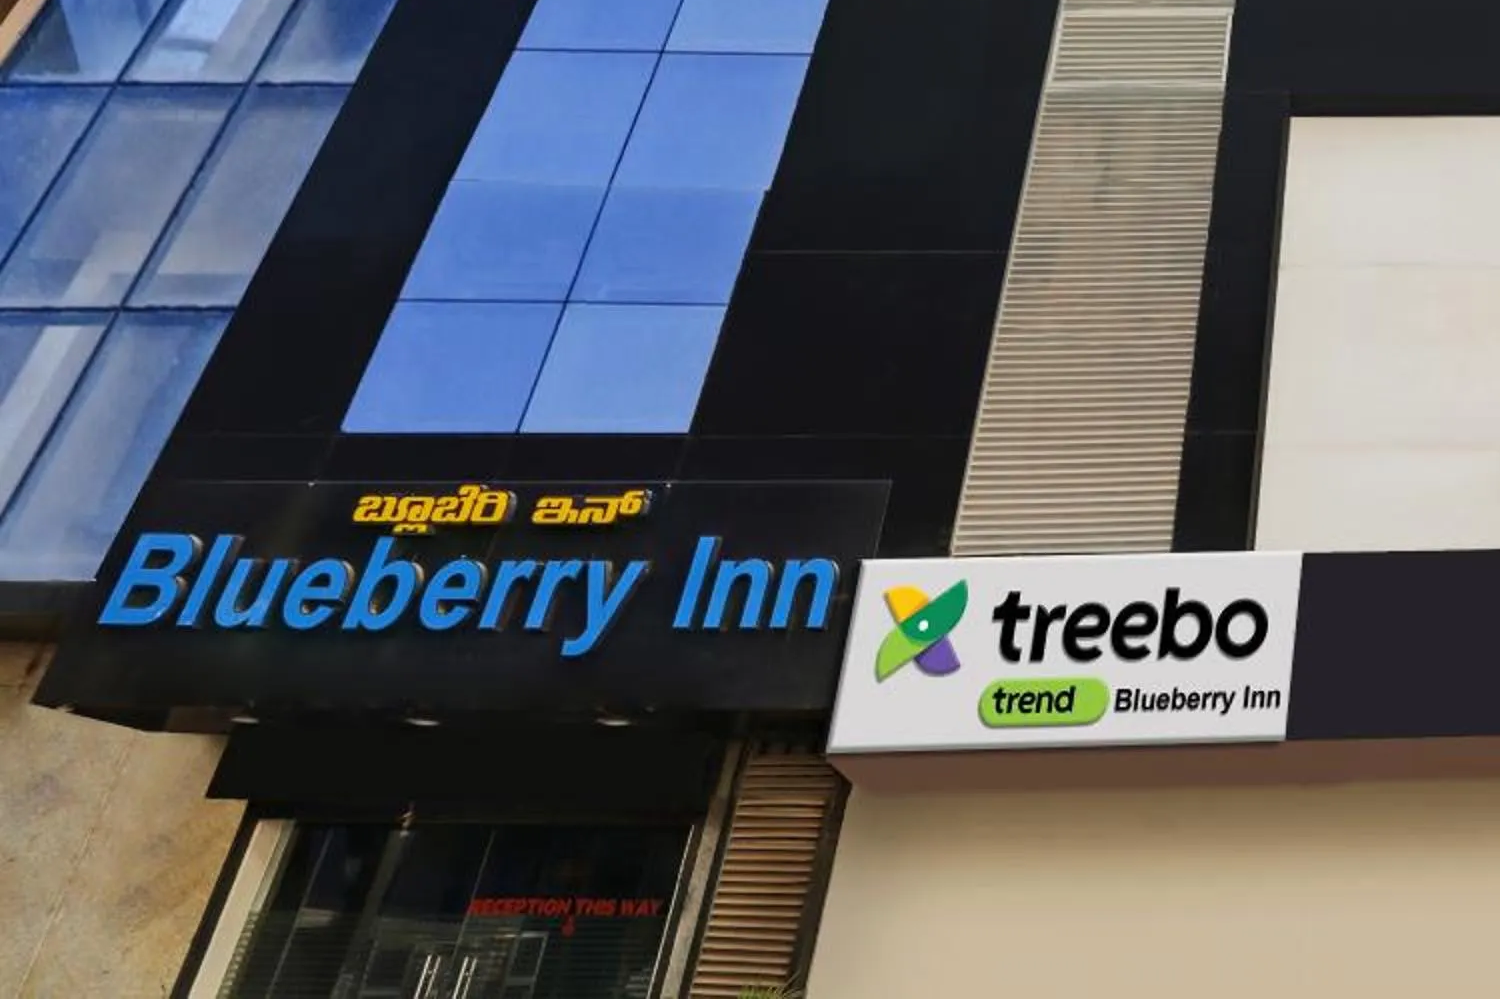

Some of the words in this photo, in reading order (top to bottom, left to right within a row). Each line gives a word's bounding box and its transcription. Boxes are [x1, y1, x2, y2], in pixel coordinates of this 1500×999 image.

[531, 490, 647, 524] ಇನ್
[98, 532, 646, 656] Blueberry
[672, 535, 836, 630] Inn
[992, 587, 1269, 662] treebo
[992, 685, 1076, 714] trend
[1114, 686, 1235, 715] Blueberry
[1243, 685, 1281, 709] Inn
[468, 898, 573, 917] RECEPTION
[574, 898, 616, 916] THIS
[619, 899, 665, 916] WAY
